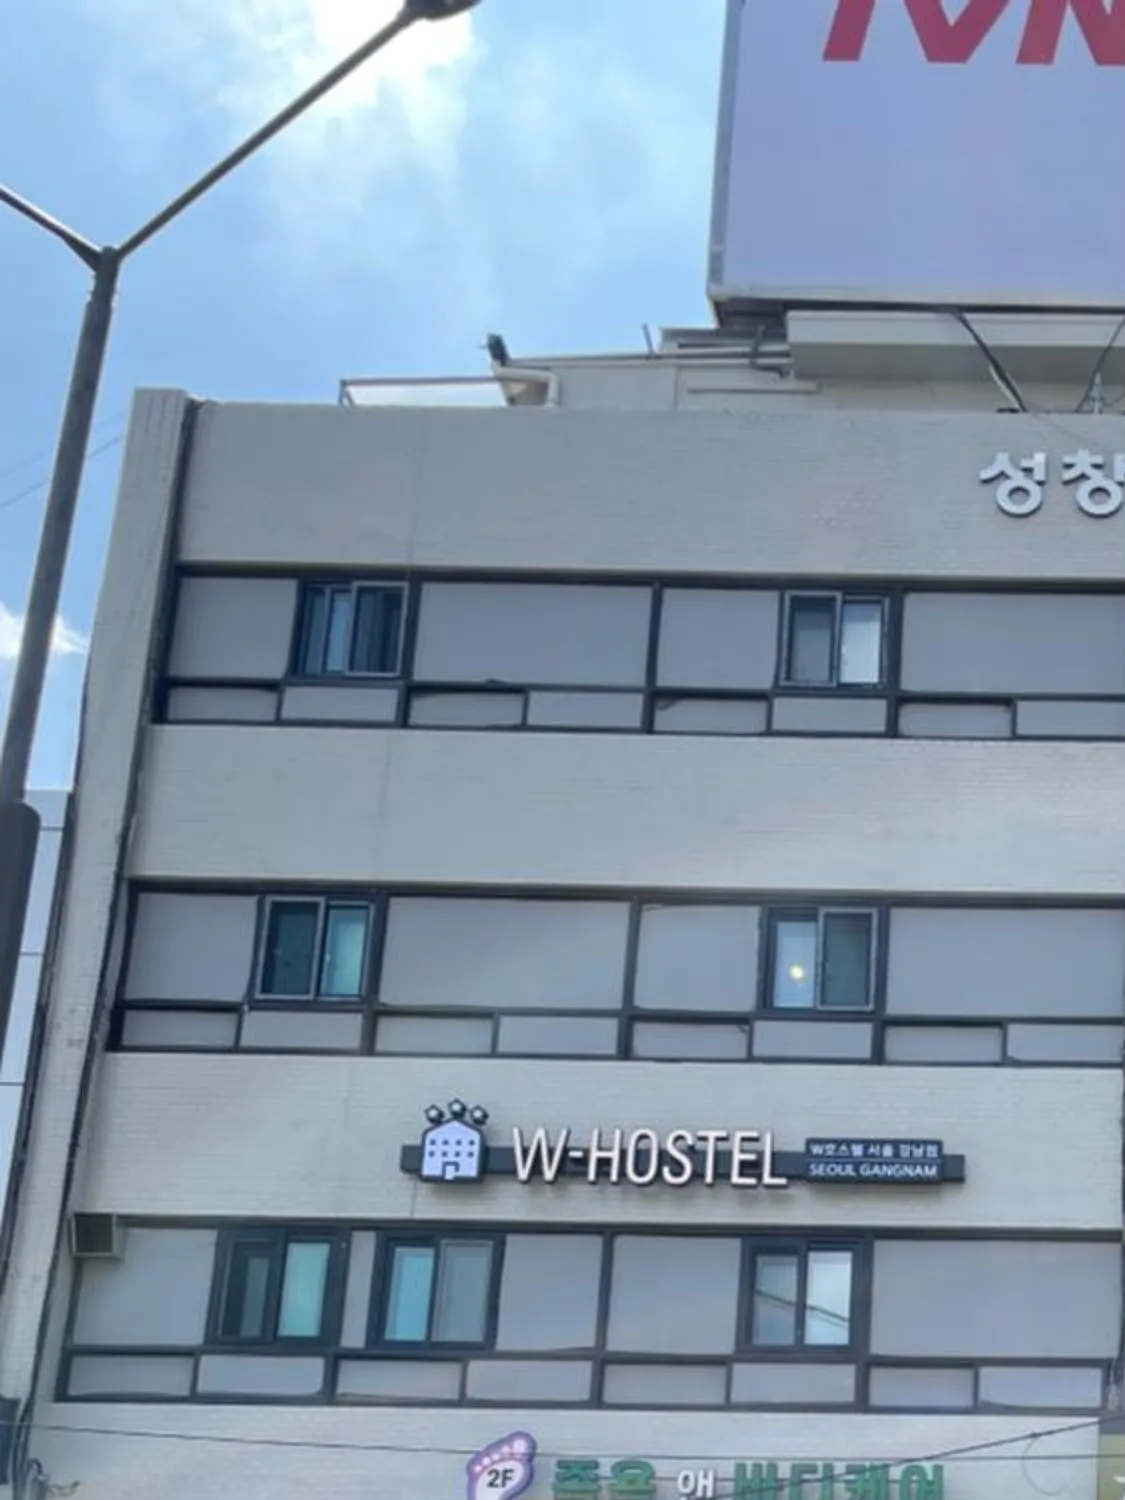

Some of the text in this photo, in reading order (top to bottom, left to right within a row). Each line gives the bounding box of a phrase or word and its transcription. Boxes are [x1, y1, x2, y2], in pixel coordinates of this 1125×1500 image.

[512, 1126, 788, 1187] W-HOSTEL
[809, 1161, 938, 1178] SEOUL GANGNAM
[486, 1469, 514, 1488] 2F
